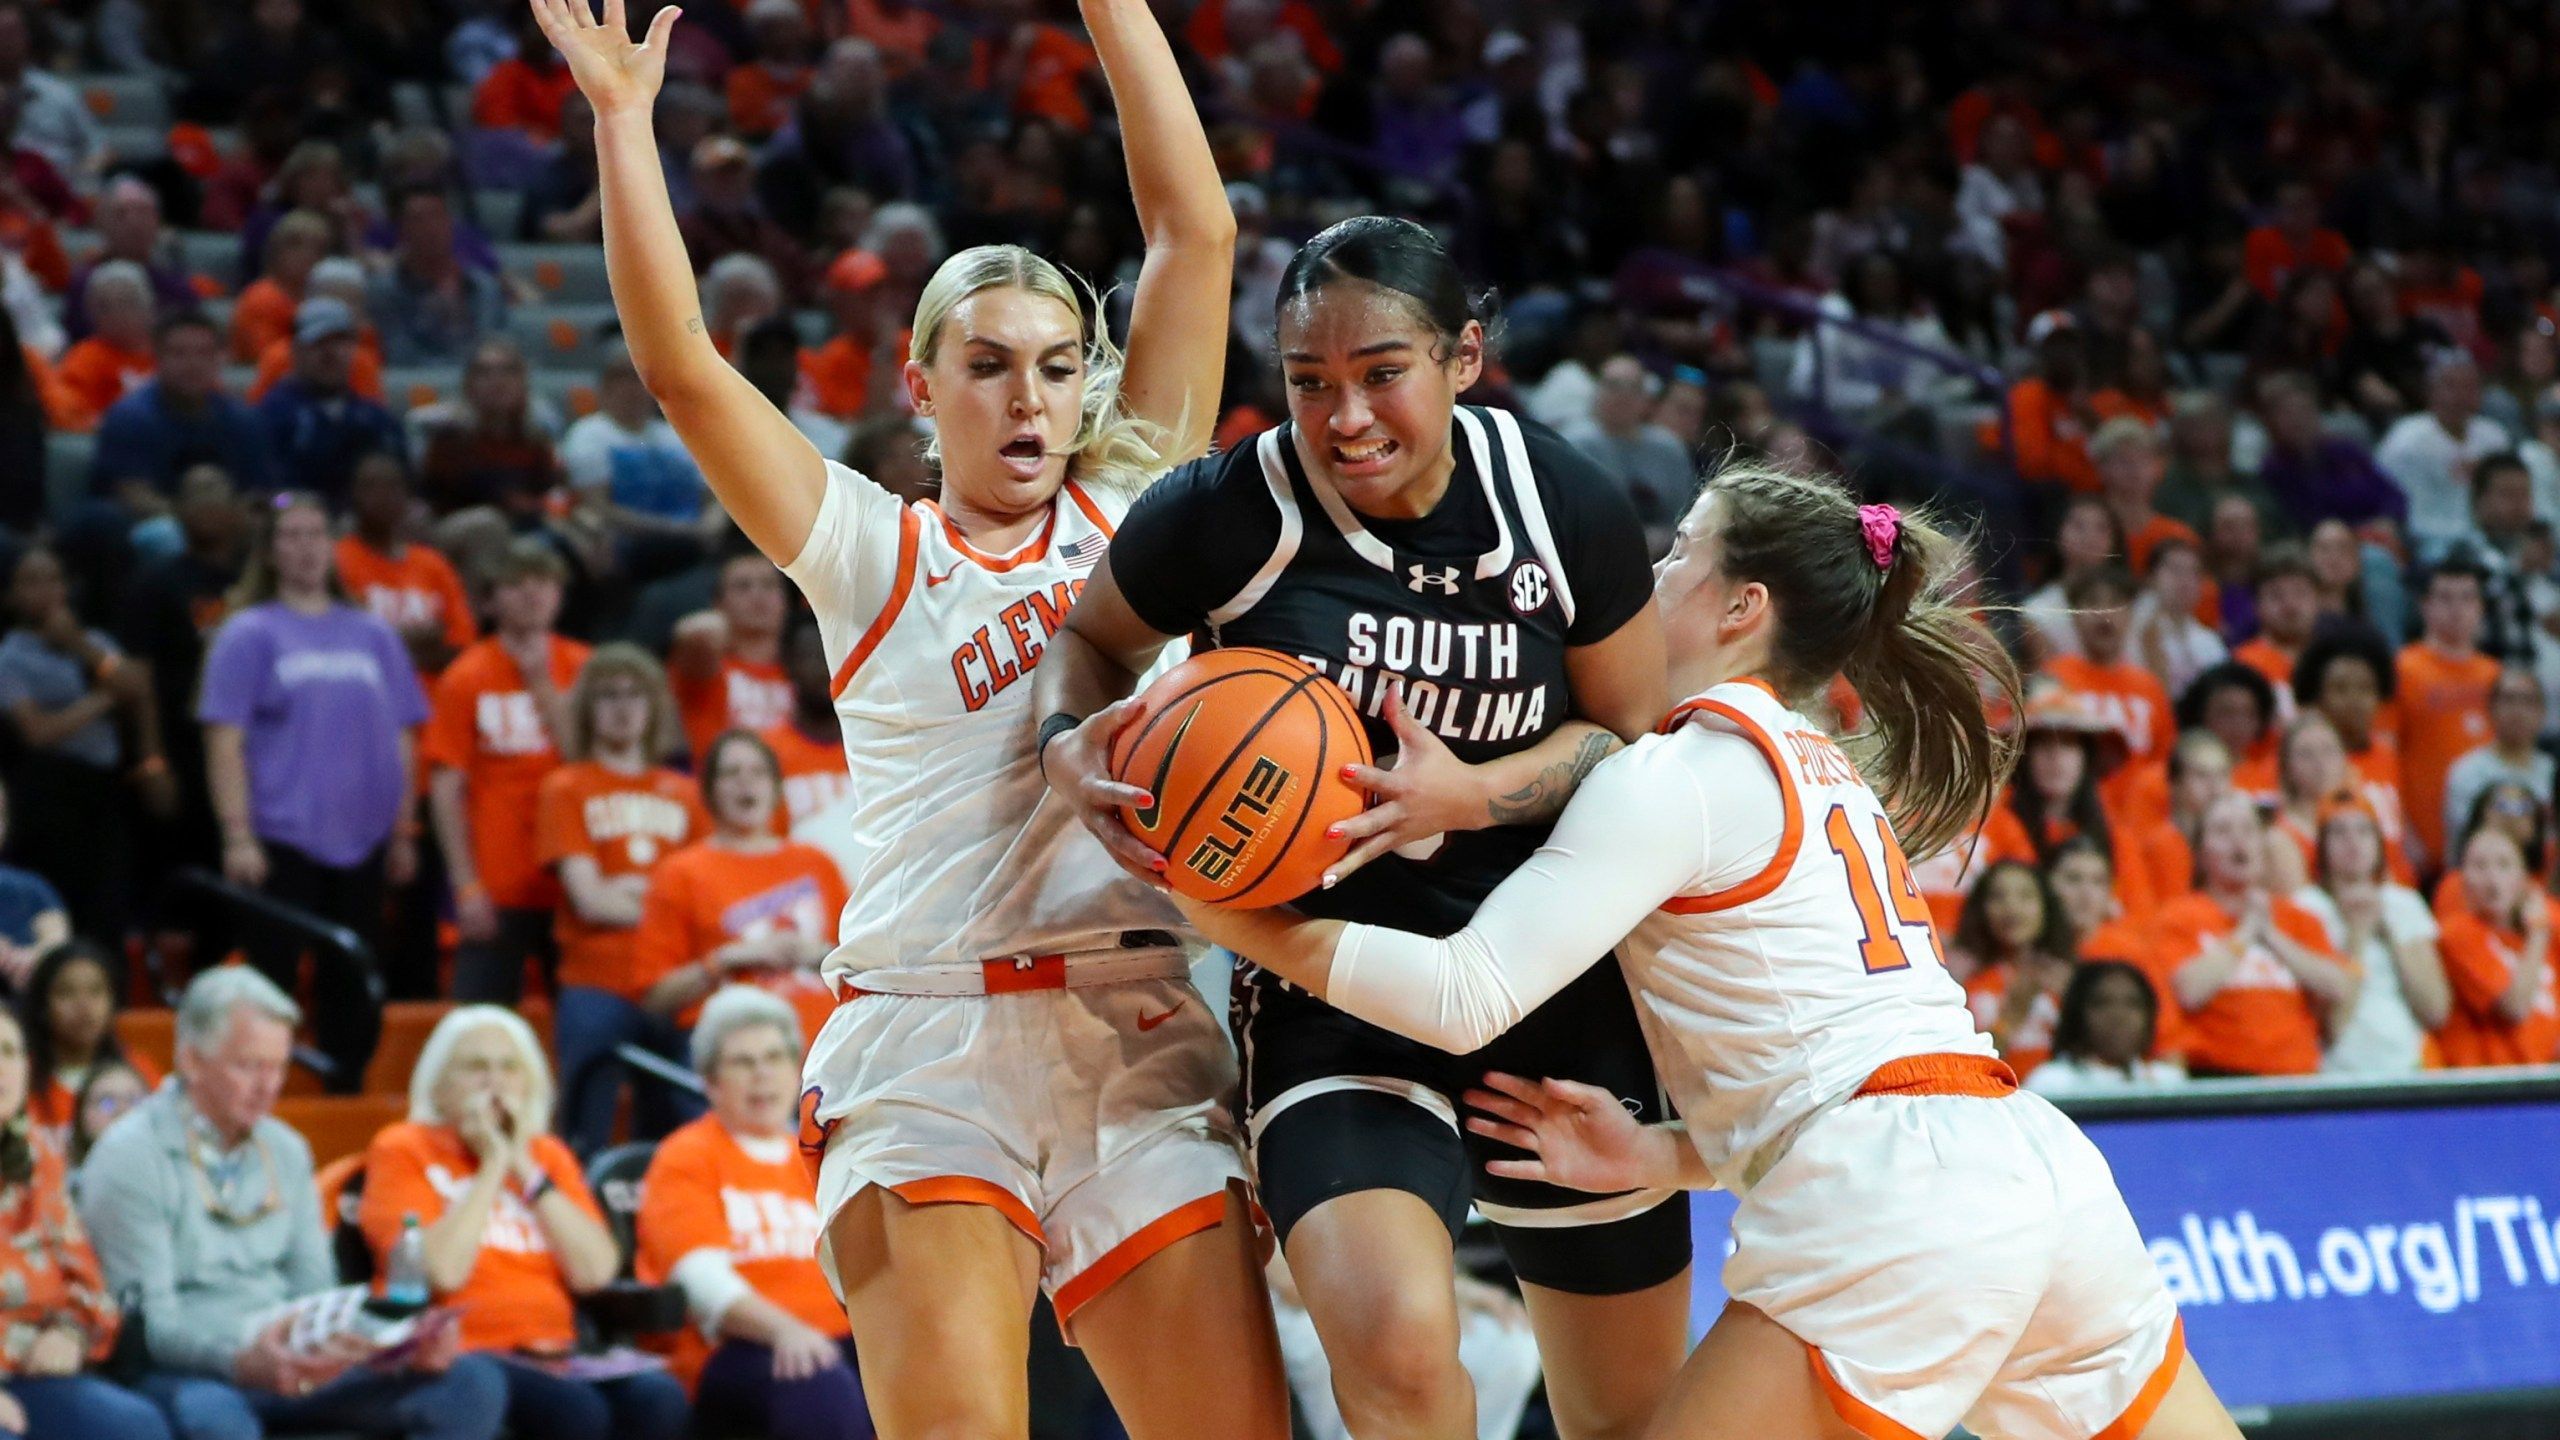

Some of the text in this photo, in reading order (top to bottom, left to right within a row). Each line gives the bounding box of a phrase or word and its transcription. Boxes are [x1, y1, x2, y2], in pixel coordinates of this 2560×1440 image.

[1511, 562, 1551, 612] SEC
[1348, 612, 1519, 680] SOUTH
[1184, 754, 1290, 883] ELITE
[1219, 775, 1300, 889] CHAMPIONSHIP
[1824, 803, 1947, 975] 14
[2147, 1194, 2560, 1315] alth.org/Ti
